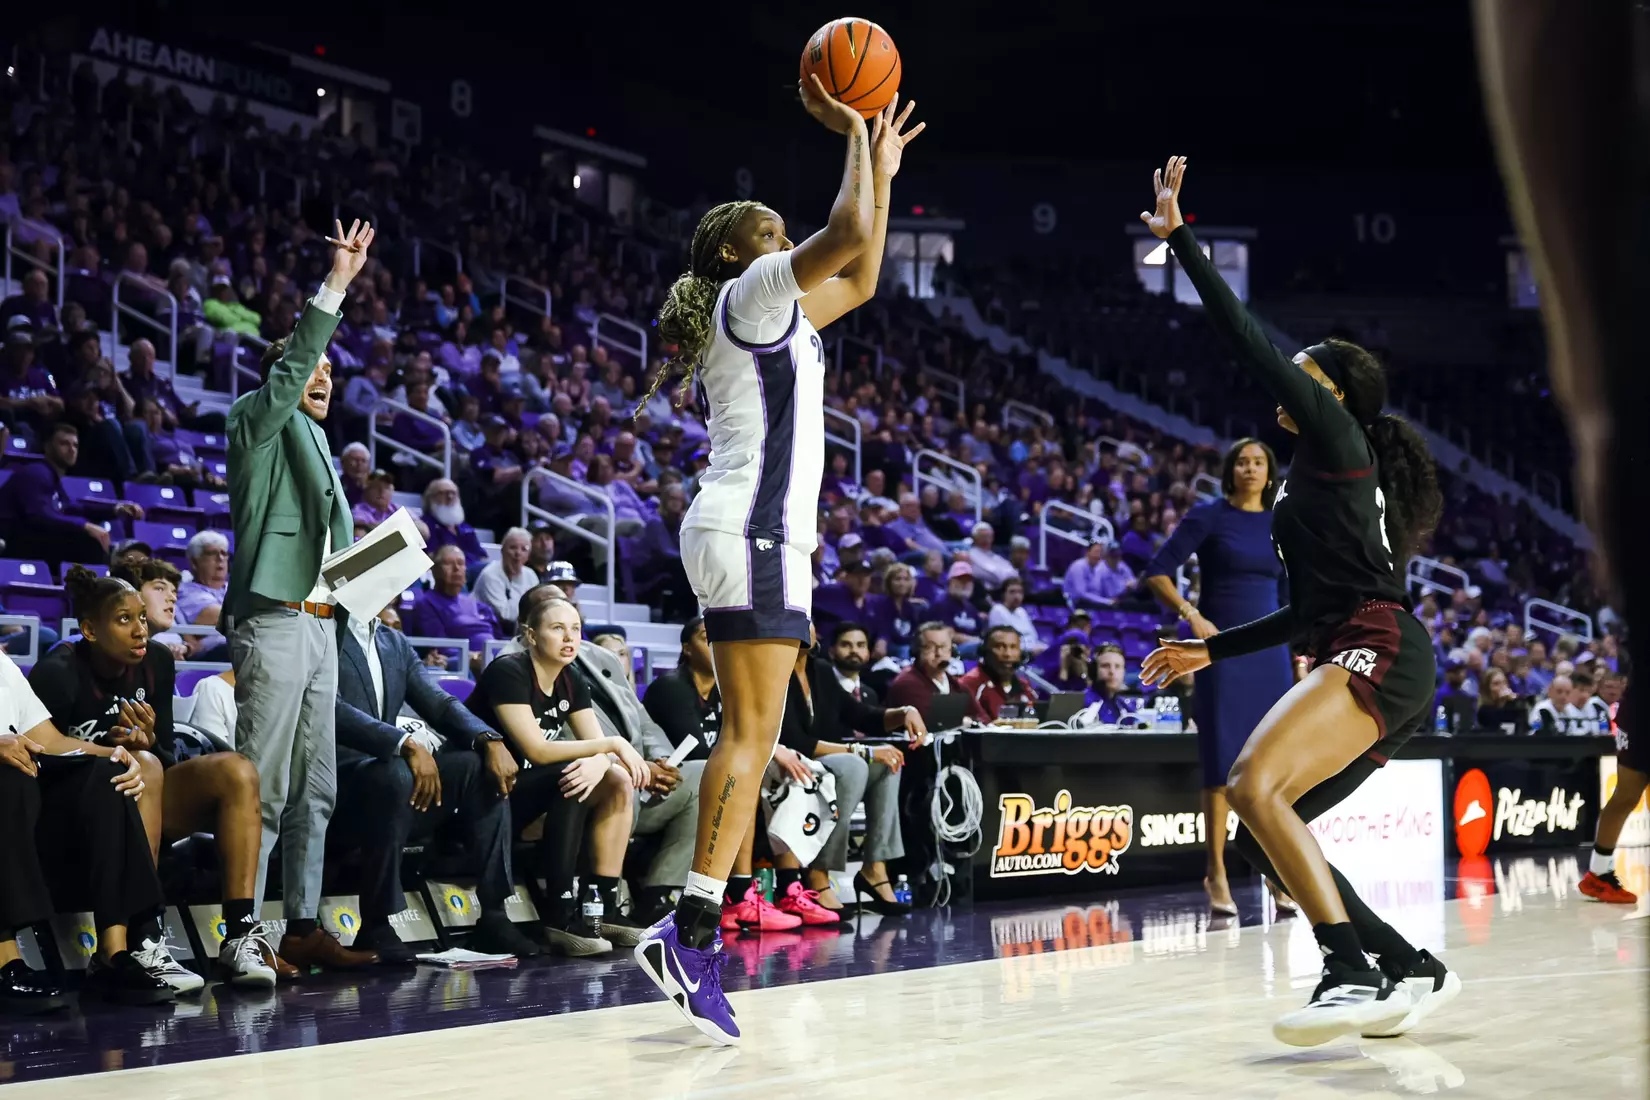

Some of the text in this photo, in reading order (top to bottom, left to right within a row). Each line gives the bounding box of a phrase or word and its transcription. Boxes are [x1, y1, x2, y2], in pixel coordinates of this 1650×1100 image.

[89, 26, 216, 84] AHEARN
[450, 79, 473, 118] 8
[1032, 202, 1057, 234] 9
[1353, 211, 1397, 244] 10
[996, 791, 1132, 870] Briggs
[1140, 810, 1240, 847] SINCE 19
[1494, 786, 1586, 840] Pizza Hut
[710, 830, 719, 842] on
[995, 852, 1063, 873] AUTO.COM
